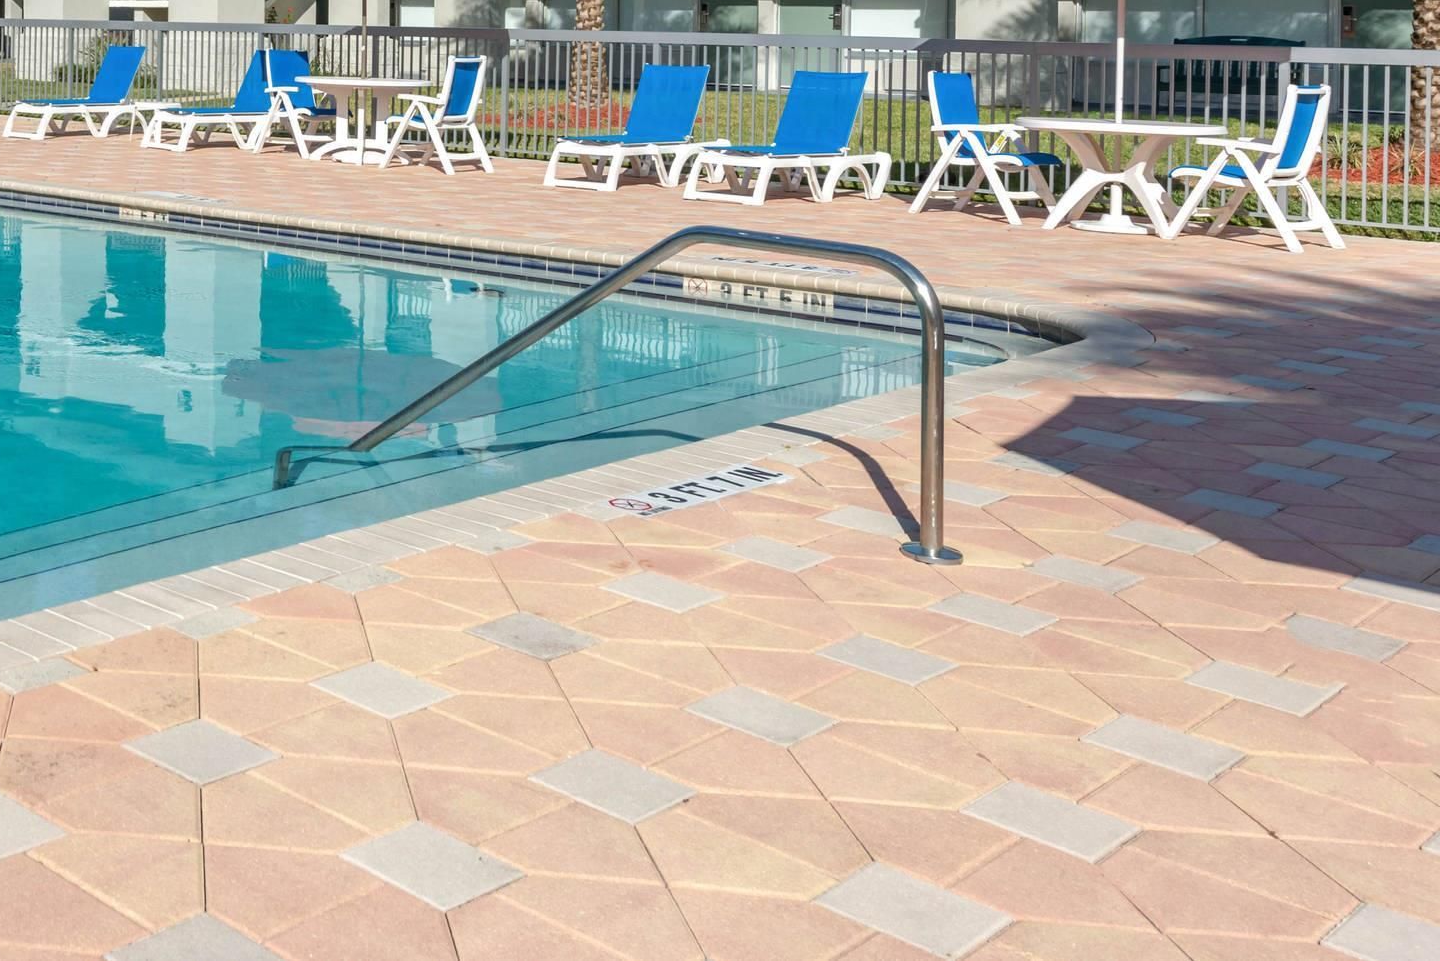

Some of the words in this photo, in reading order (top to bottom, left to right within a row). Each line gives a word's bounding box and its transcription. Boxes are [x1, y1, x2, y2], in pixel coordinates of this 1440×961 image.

[647, 492, 688, 503] 3
[670, 481, 727, 498] FT.
[706, 475, 745, 488] 7
[727, 466, 783, 483] IN.
